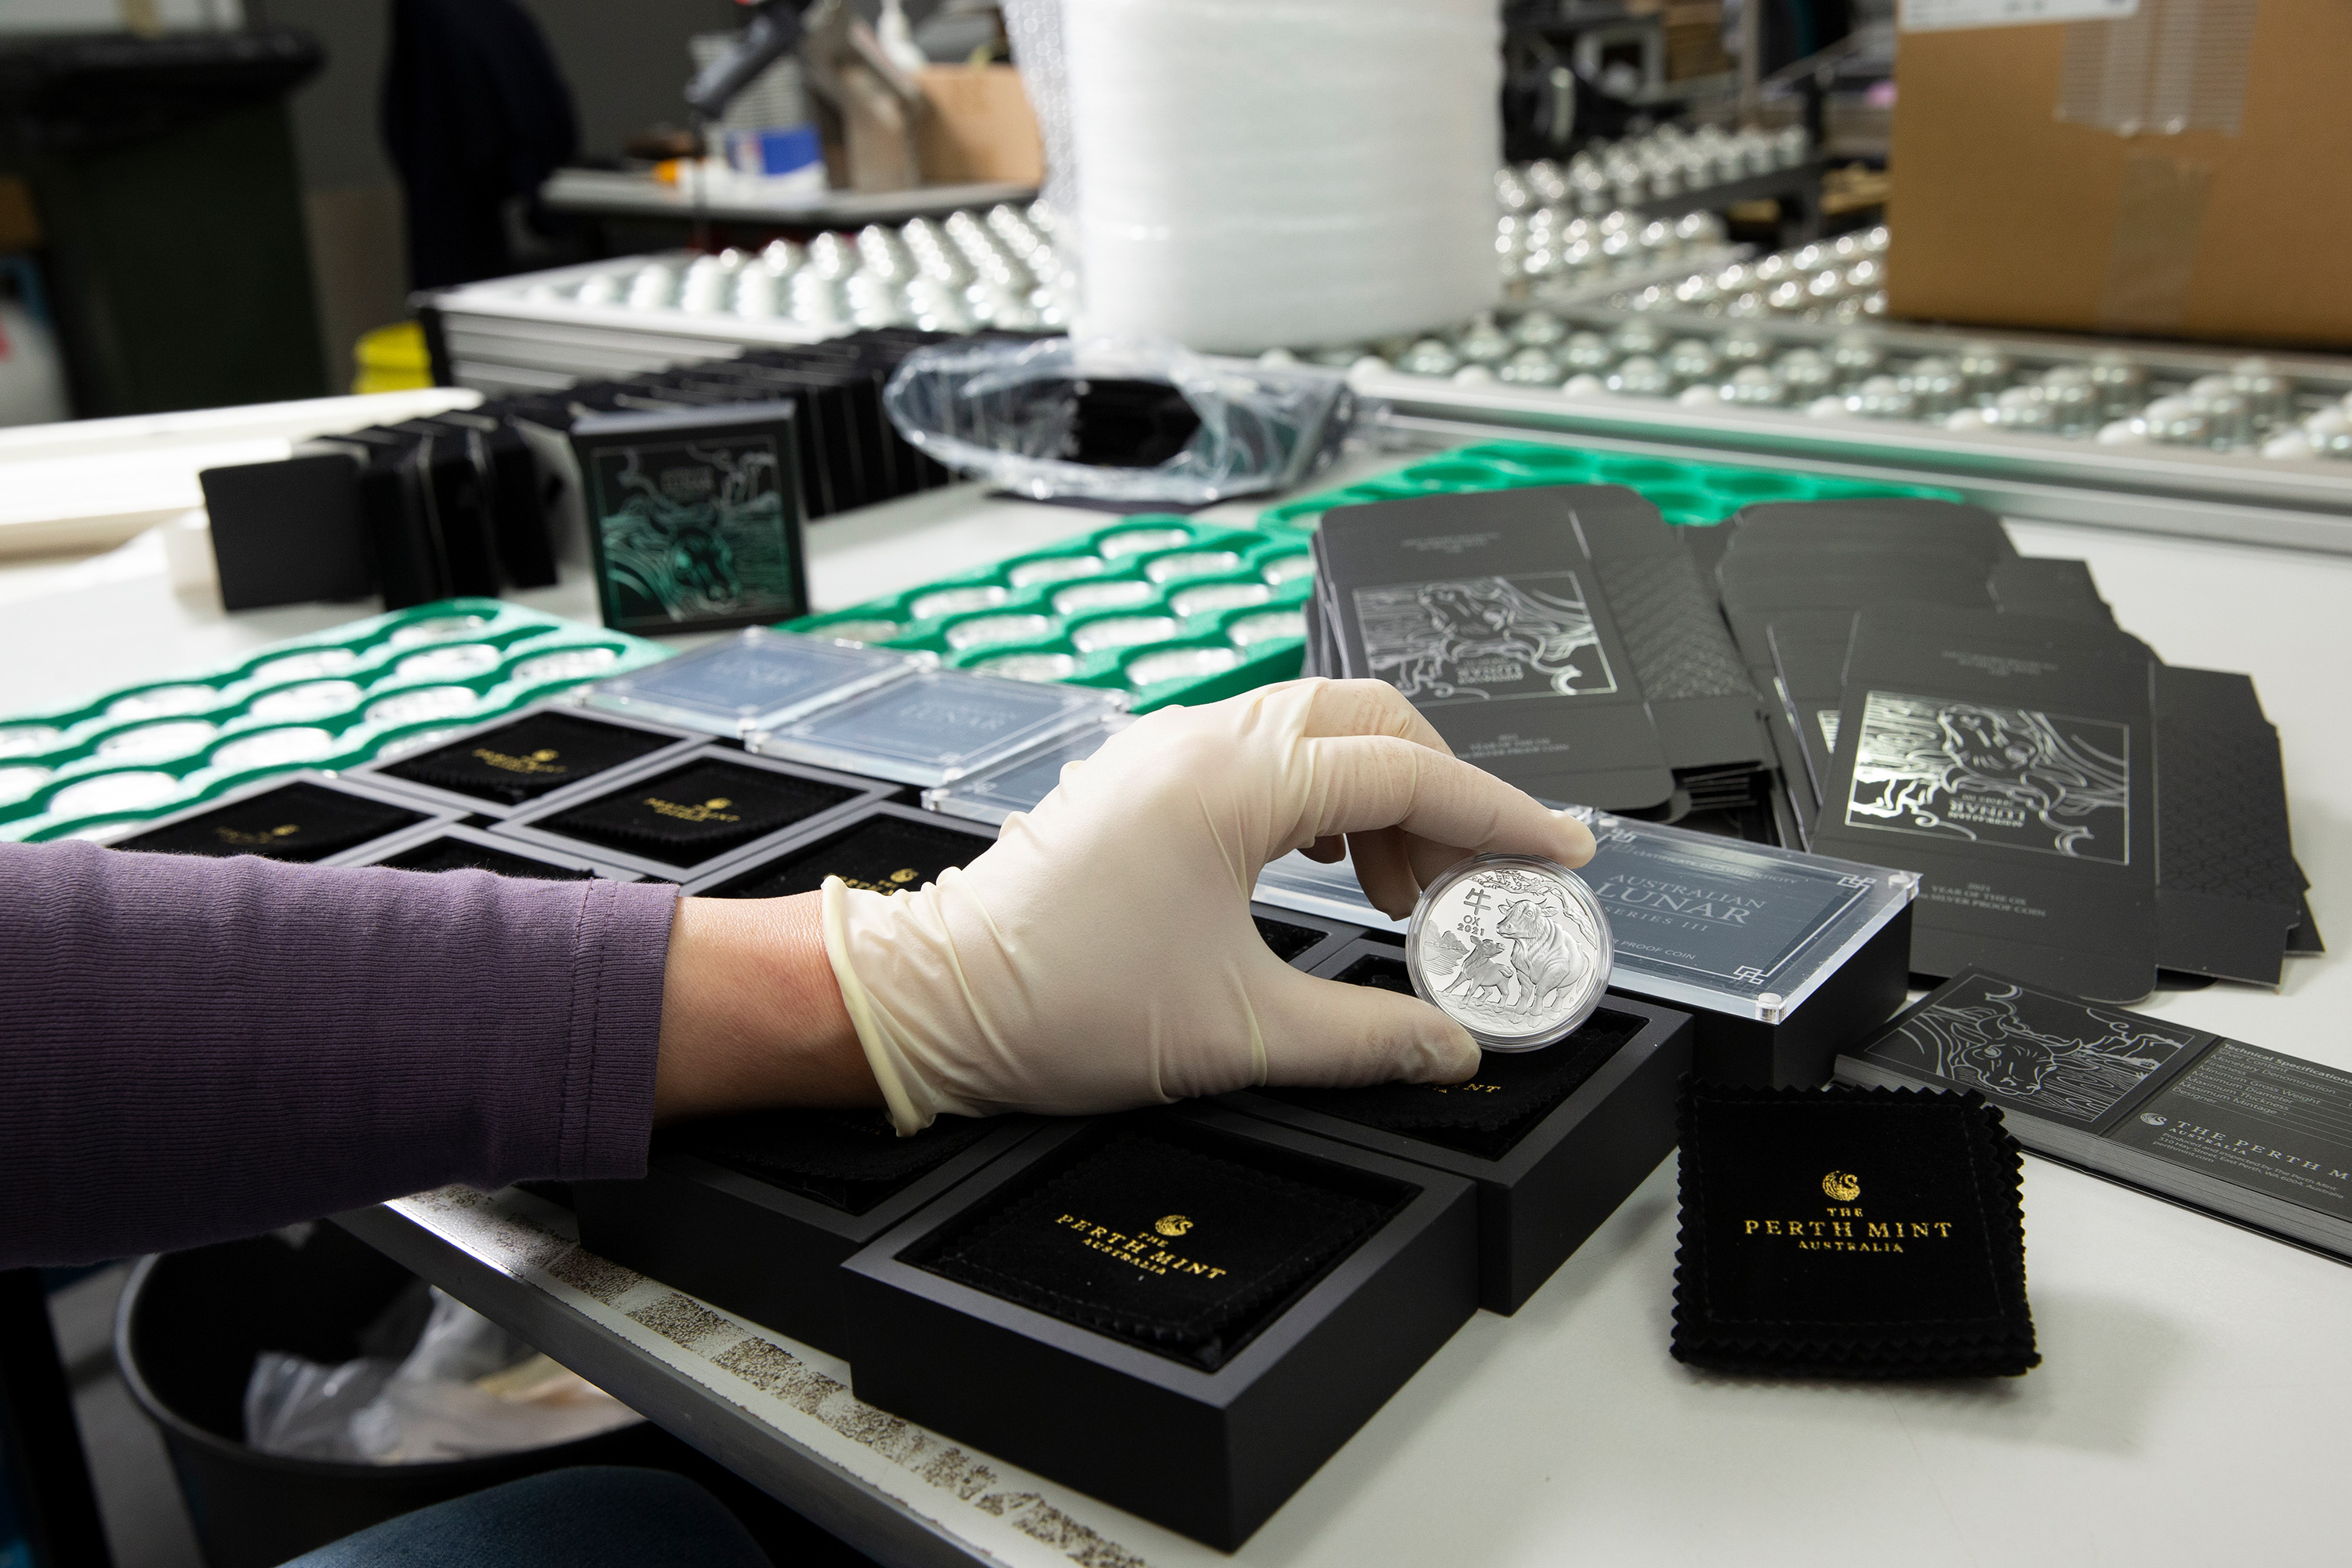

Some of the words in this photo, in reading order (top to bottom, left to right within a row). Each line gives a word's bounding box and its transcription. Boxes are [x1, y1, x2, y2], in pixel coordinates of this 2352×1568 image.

[1595, 883, 1751, 924] LUNAR
[1610, 873, 1767, 909] AUSTRALIAN
[1457, 923, 1485, 936] 2021
[1463, 915, 1480, 927] OX
[1604, 906, 1673, 925] SERIES
[1682, 921, 1709, 931] III
[1621, 941, 1663, 953] PROOF
[1664, 949, 1696, 960] COIN
[2205, 1059, 2247, 1076] Fineness
[2211, 1054, 2259, 1073] Monetary
[2262, 1069, 2336, 1094] Denomination
[2219, 1048, 2244, 1060] Silver
[2246, 1058, 2289, 1073] Content
[2224, 1044, 2274, 1062] Technical
[2275, 1058, 2352, 1085] Specifications
[2172, 1087, 2219, 1104] Designer
[2179, 1081, 2230, 1100] Maximum
[2233, 1098, 2278, 1114] Mintage
[2186, 1076, 2238, 1094] Maximum
[2241, 1092, 2290, 1111] Thickness
[2192, 1070, 2243, 1089] Maximum
[2245, 1087, 2295, 1104] Diameter
[2198, 1065, 2247, 1083] Minimum
[2250, 1080, 2279, 1093] Gross
[2282, 1089, 2321, 1105] Weight
[2169, 1127, 2247, 1155] AUSTRALIA
[2177, 1120, 2227, 1141] THE
[2234, 1139, 2321, 1171] PERTH
[2163, 1132, 2202, 1148] Produced
[2202, 1144, 2220, 1153] and
[2220, 1149, 2262, 1167] inspected
[2274, 1168, 2291, 1177] The
[2291, 1173, 2316, 1184] Perth
[2316, 1181, 2337, 1191] Mint
[2176, 1142, 2192, 1151] Hay
[2306, 1184, 2345, 1199] Australia
[1827, 1207, 1864, 1217] THE
[1138, 1232, 1169, 1247] THE
[1744, 1220, 1854, 1237] PERTH
[1867, 1221, 1952, 1238] MINT
[1055, 1214, 1148, 1254] PERTH
[1149, 1250, 1226, 1279] MINT
[1082, 1238, 1167, 1276] AUSTRALIA
[1798, 1240, 1904, 1253] AUSTRALIA
